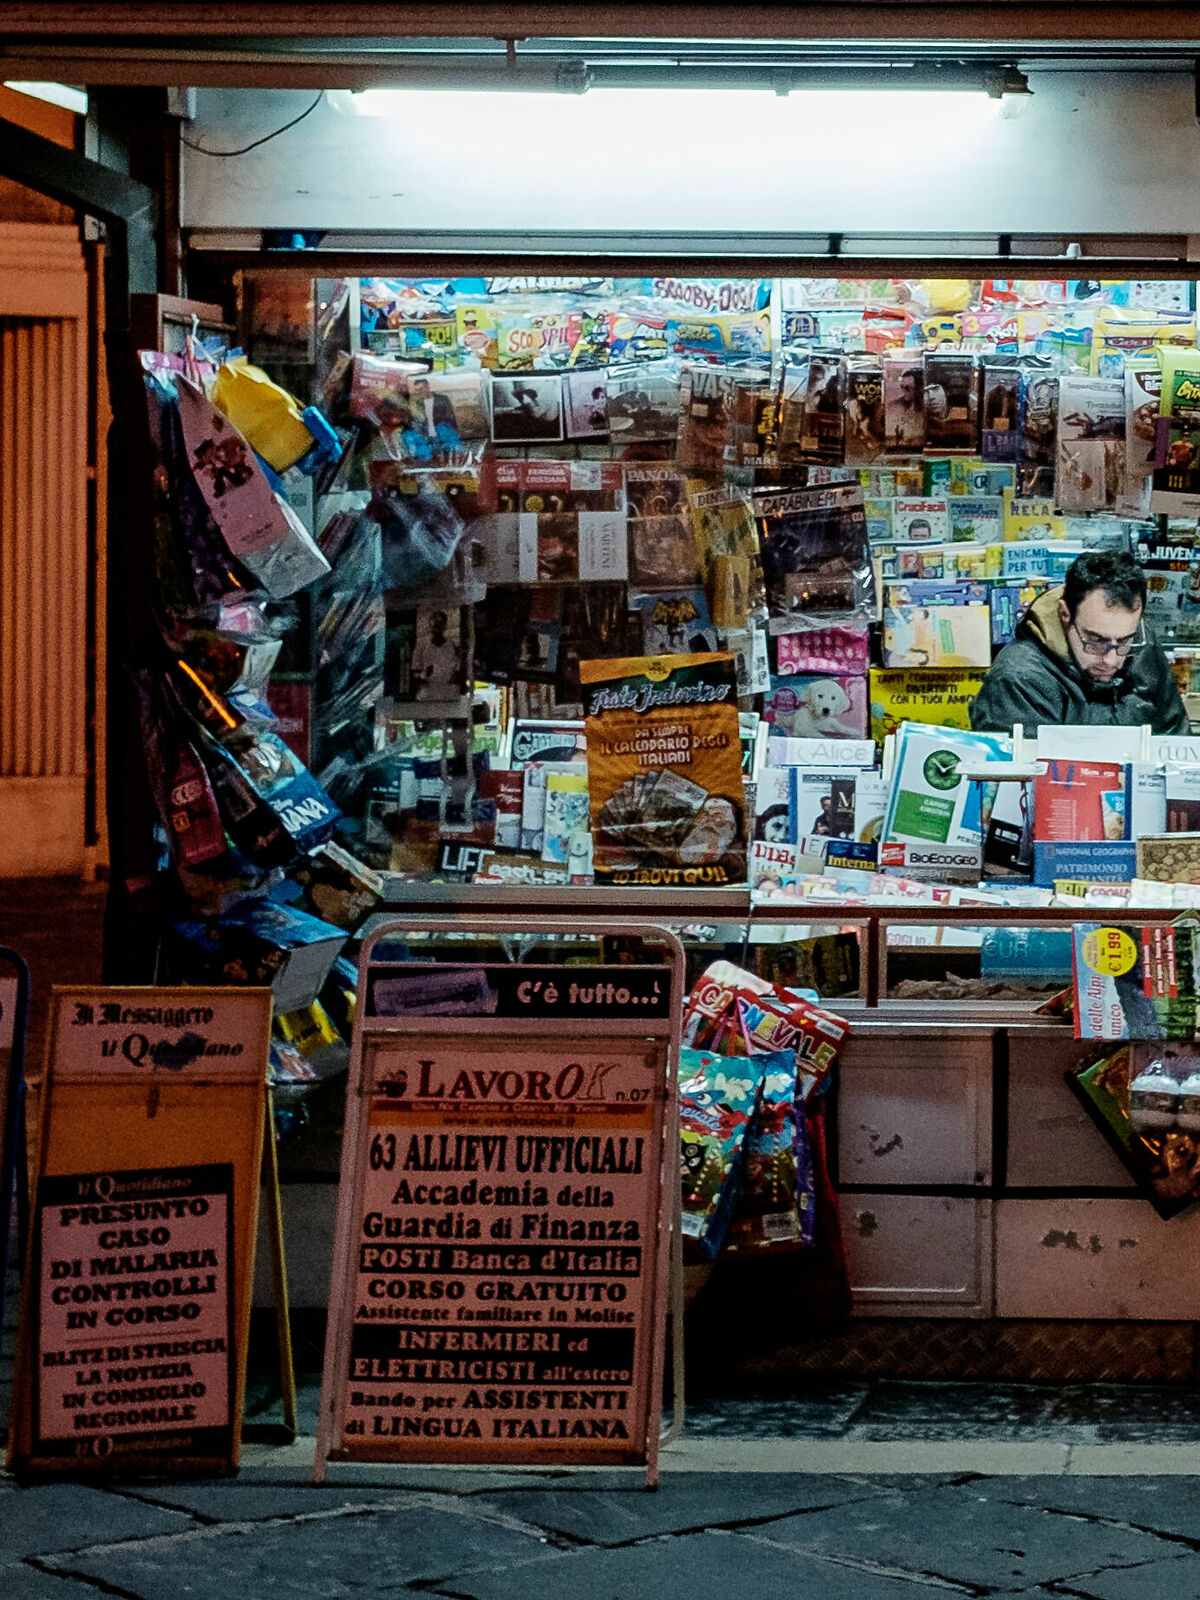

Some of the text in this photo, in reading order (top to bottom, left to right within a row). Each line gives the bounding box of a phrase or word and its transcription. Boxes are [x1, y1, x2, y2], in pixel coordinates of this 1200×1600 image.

[517, 980, 559, 1004] C'è
[98, 1002, 214, 1028] Messaggero
[369, 1133, 644, 1174] 63 ALLIEVI UFFICIALI
[391, 1179, 615, 1207] Accademia della
[60, 1197, 209, 1227] PRESUNTO
[99, 1226, 170, 1250] CASO
[363, 1211, 640, 1240] Guardia di Finanza
[51, 1249, 218, 1280] DI MALARIA
[363, 1248, 638, 1272] POSTI Banca d'Italia
[52, 1275, 216, 1305] CONTROLLI
[368, 1279, 627, 1302] CORSO GRATUITO
[66, 1303, 200, 1329] IN CORSO
[356, 1304, 634, 1323] Assistente familiare in Molise
[43, 1339, 225, 1367] BLITZ DI STRISCIA
[399, 1330, 589, 1352] INFERMIERI ed
[75, 1362, 194, 1386] LA NOTIZIA
[353, 1358, 631, 1381] ELETTRICISTI all'estero
[62, 1382, 206, 1409] IN CONSIGLIO
[350, 1389, 628, 1412] Bando per ASSISTENTI
[73, 1405, 197, 1430] REGIONALE
[372, 1416, 482, 1438] LINGUA
[492, 1418, 630, 1439] ITALIANA
